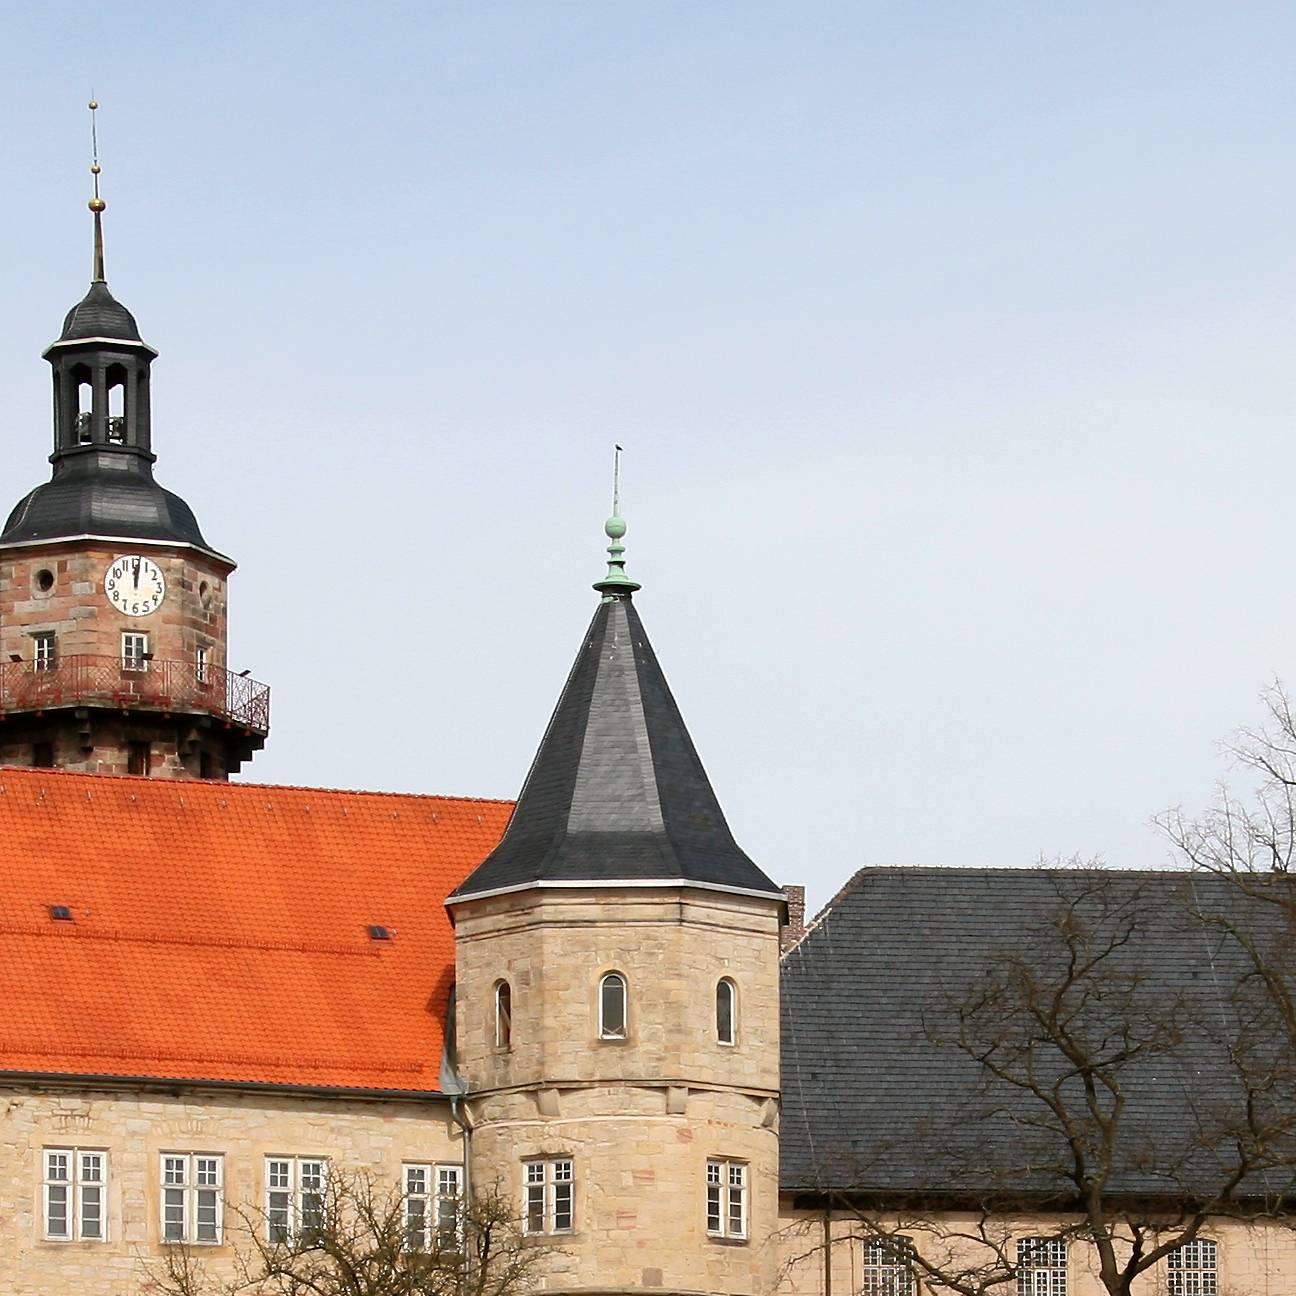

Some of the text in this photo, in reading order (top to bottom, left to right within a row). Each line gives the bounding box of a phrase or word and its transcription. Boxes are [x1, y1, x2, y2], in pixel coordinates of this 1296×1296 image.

[122, 560, 129, 572] 11
[144, 562, 148, 573] 1
[112, 567, 122, 579] 10
[151, 569, 158, 580] 2
[107, 579, 115, 591] 9
[155, 582, 163, 594] 3
[112, 590, 120, 602] 8
[152, 594, 159, 606] 4
[121, 599, 128, 611] 7
[132, 603, 139, 614] 6
[142, 600, 150, 613] 5
